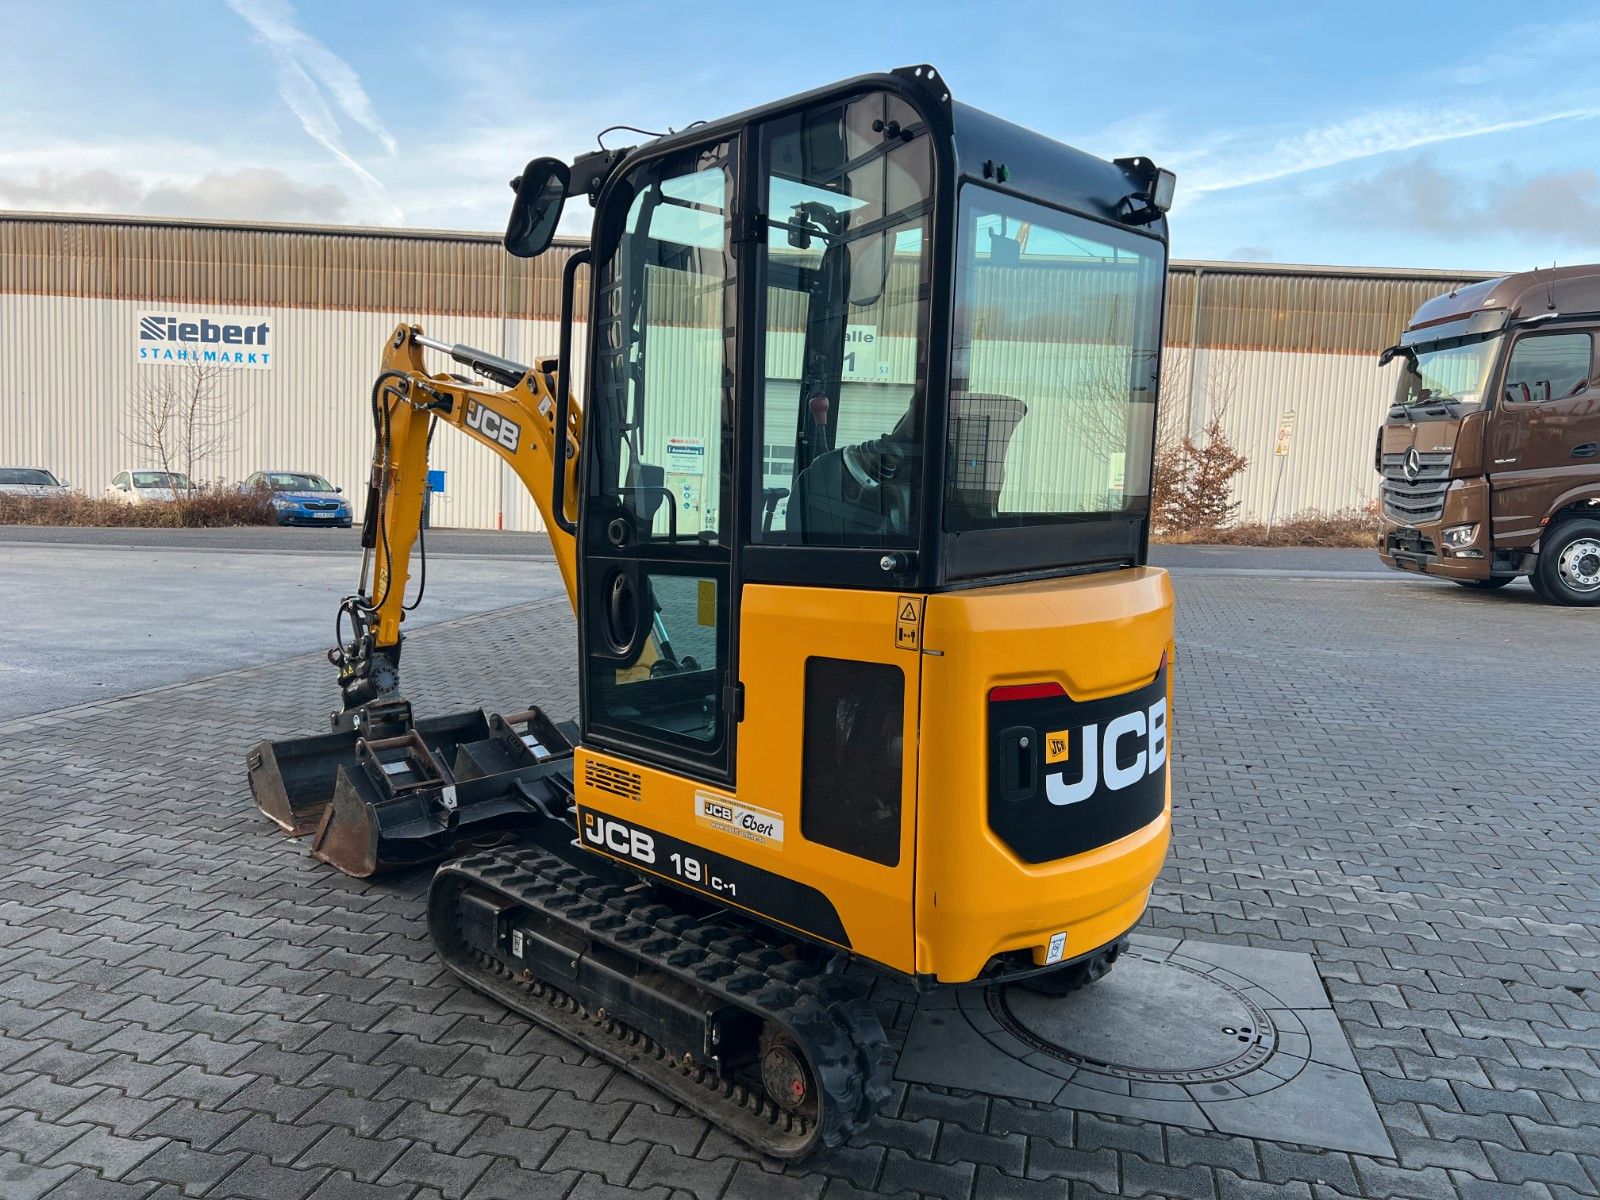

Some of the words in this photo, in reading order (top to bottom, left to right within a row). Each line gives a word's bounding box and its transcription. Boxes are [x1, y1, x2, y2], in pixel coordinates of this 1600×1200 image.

[140, 316, 270, 345] Siebert
[845, 331, 874, 343] alle
[140, 347, 270, 364] STAHLMARKT
[844, 352, 856, 372] 1
[466, 404, 519, 450] JCB
[1046, 696, 1167, 805] JCB
[1051, 739, 1066, 755] JCB
[705, 803, 732, 820] JCB
[742, 814, 774, 837] Ebert
[586, 817, 656, 864] JCB
[670, 852, 701, 882] 19
